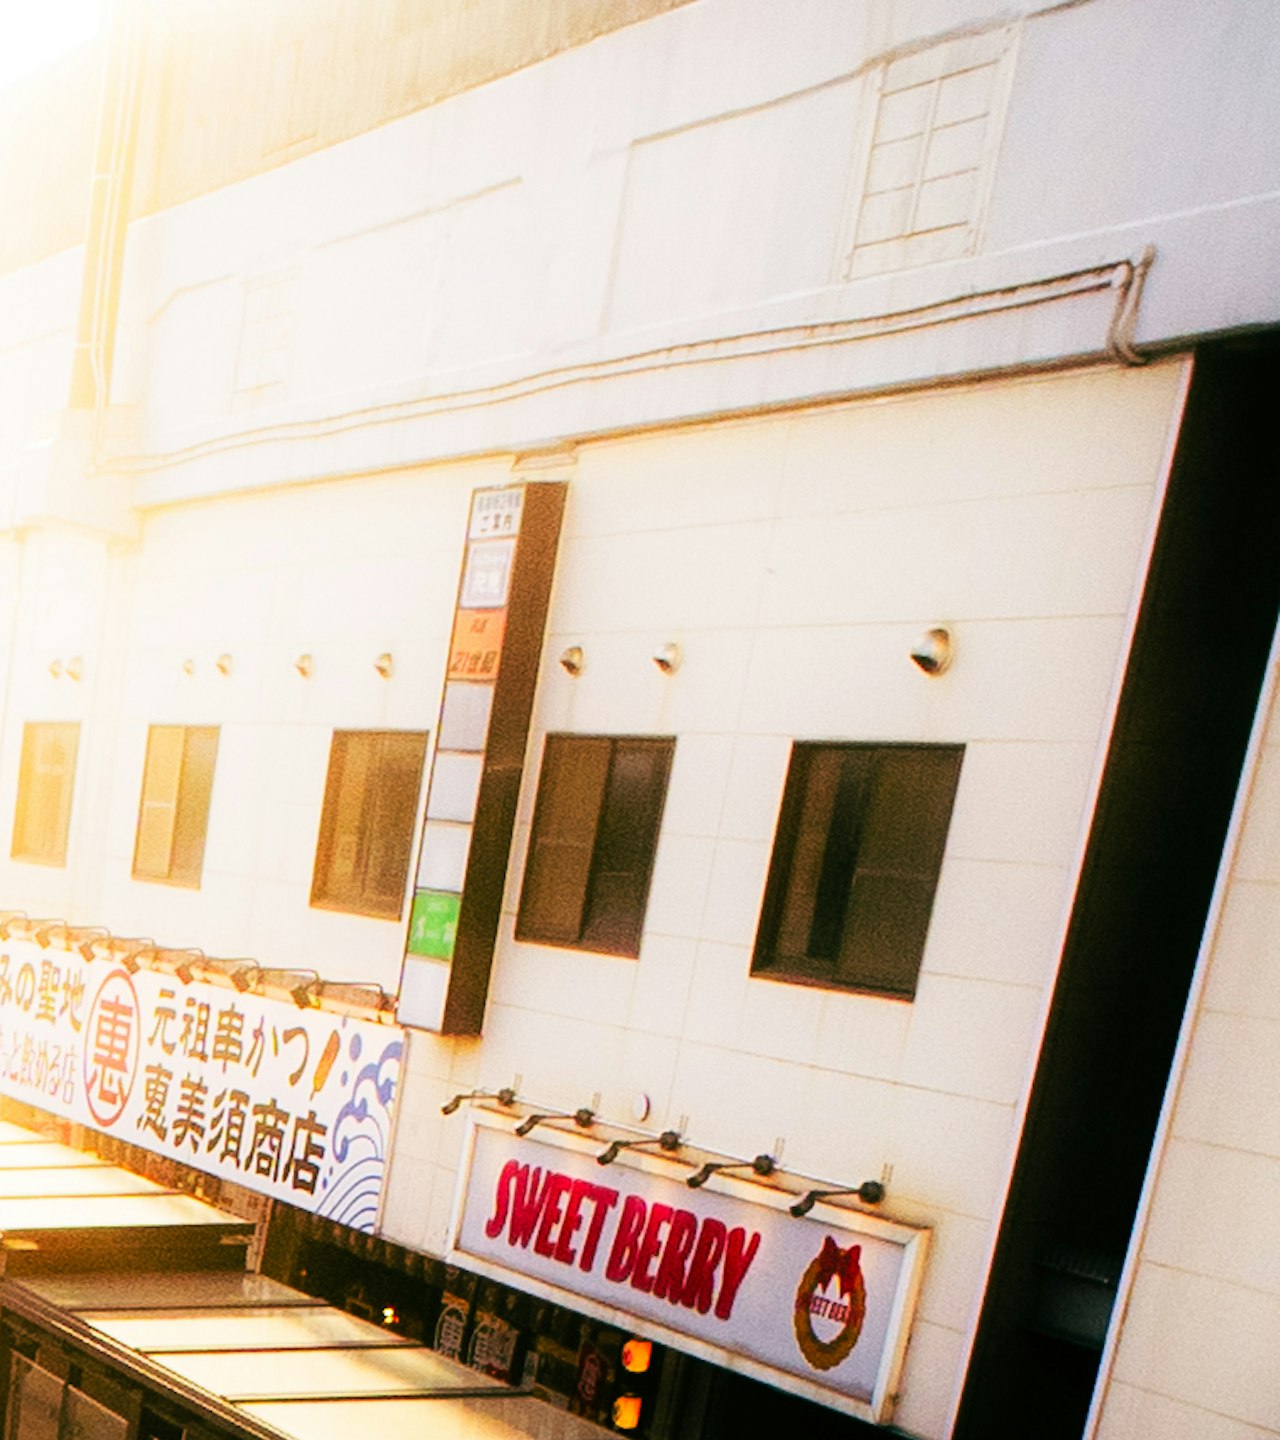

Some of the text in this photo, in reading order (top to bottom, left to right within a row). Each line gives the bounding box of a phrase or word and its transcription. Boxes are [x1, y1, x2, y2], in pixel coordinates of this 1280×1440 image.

[146, 987, 310, 1087] 元祖串かつ
[485, 1158, 761, 1321] SWEET BERRY
